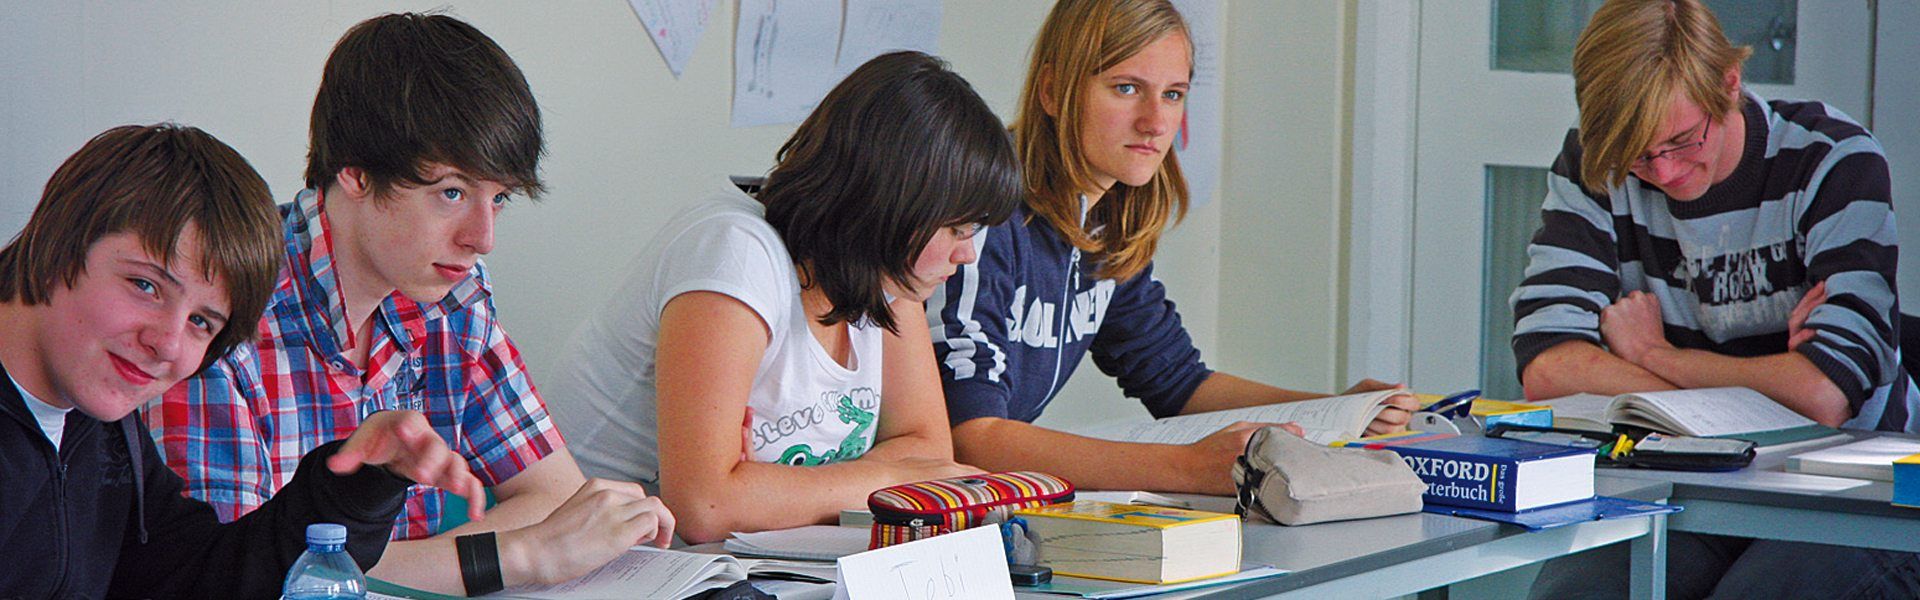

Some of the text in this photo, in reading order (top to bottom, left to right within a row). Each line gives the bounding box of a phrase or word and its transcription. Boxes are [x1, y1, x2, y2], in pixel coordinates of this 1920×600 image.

[1713, 262, 1774, 303] ROCK
[1402, 455, 1489, 482] OXFORD
[1425, 481, 1488, 502] rterbuch
